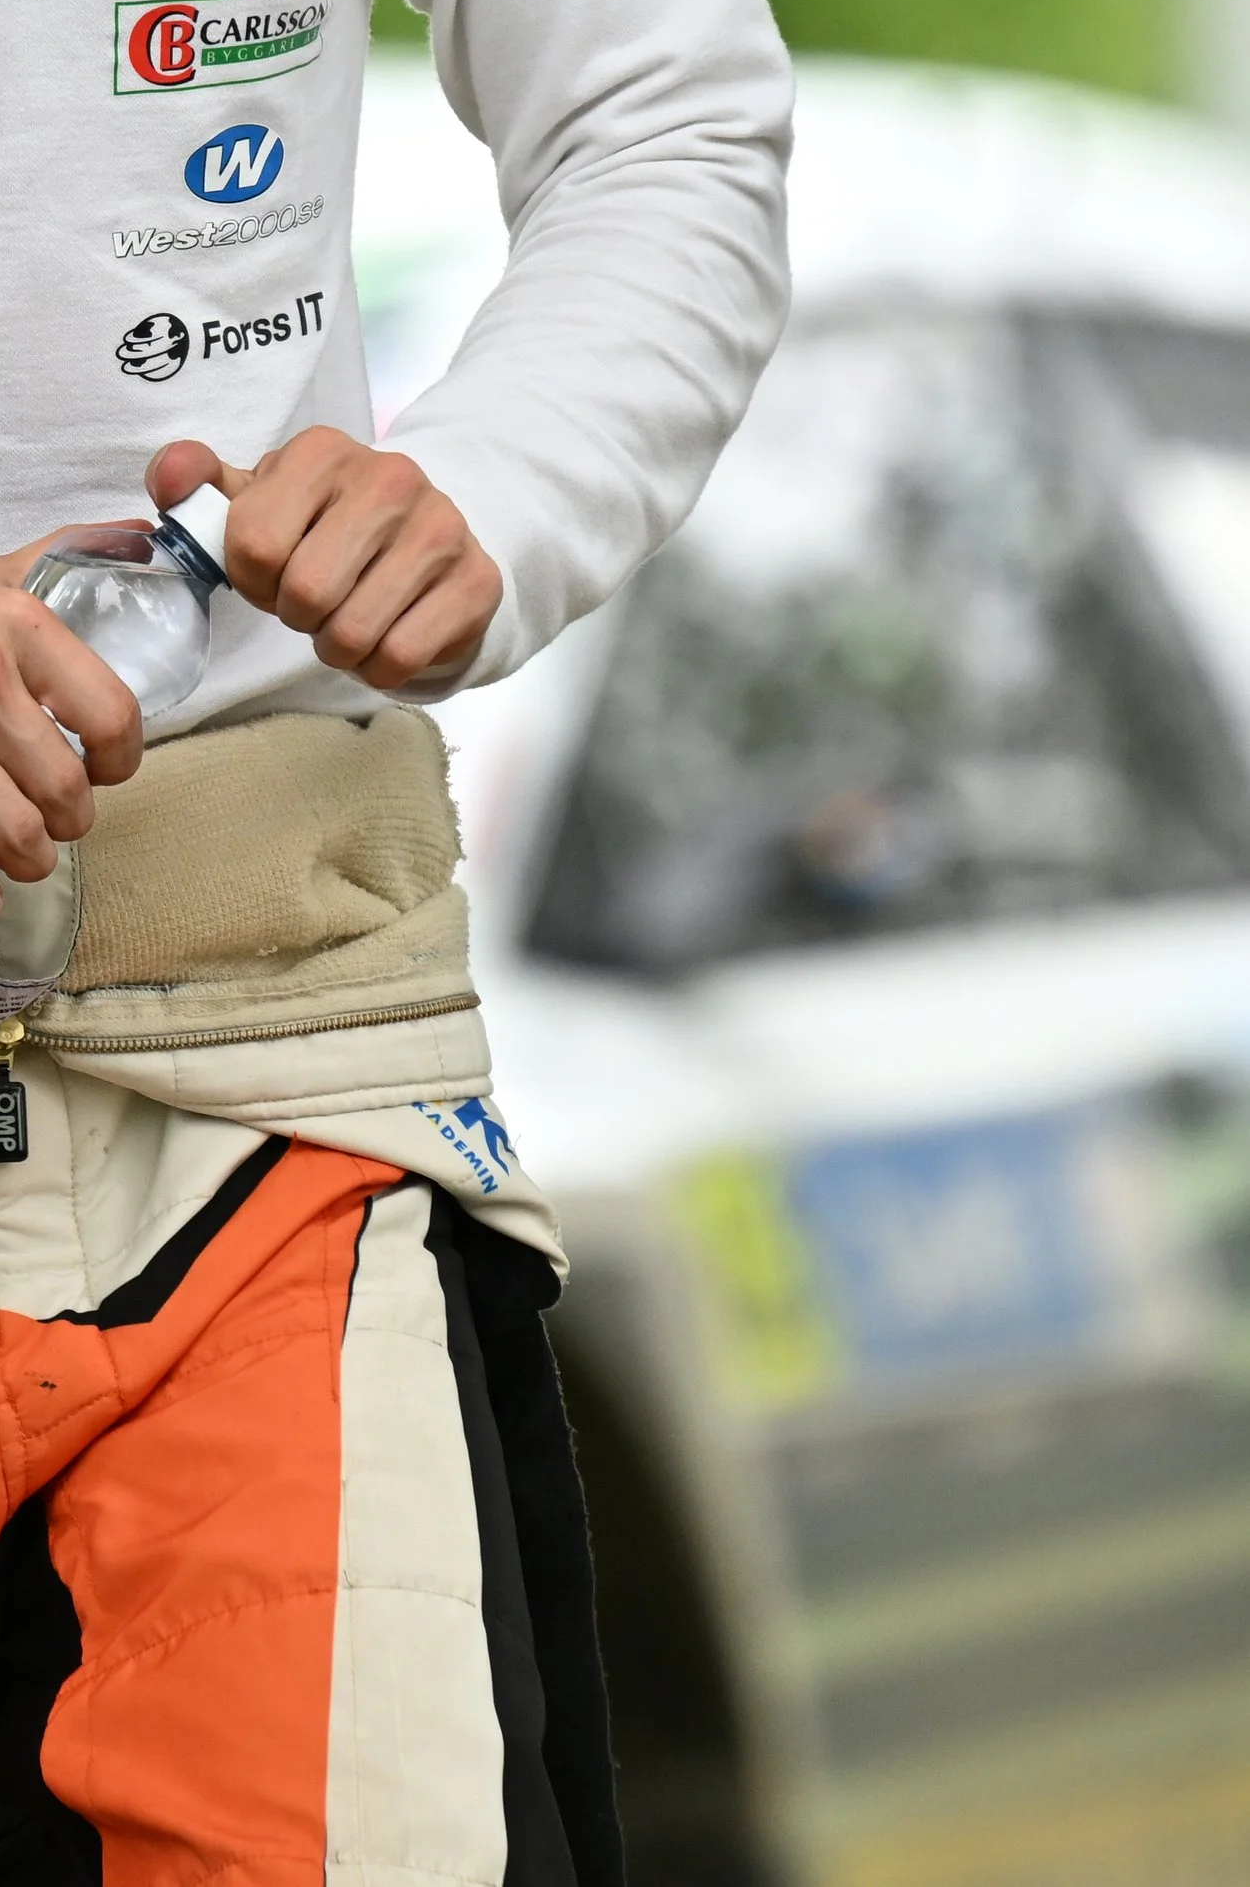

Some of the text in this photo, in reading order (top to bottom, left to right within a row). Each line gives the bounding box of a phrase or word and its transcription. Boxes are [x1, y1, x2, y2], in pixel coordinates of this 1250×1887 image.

[112, 195, 324, 258] West2000.se
[202, 291, 324, 359] Forss IT
